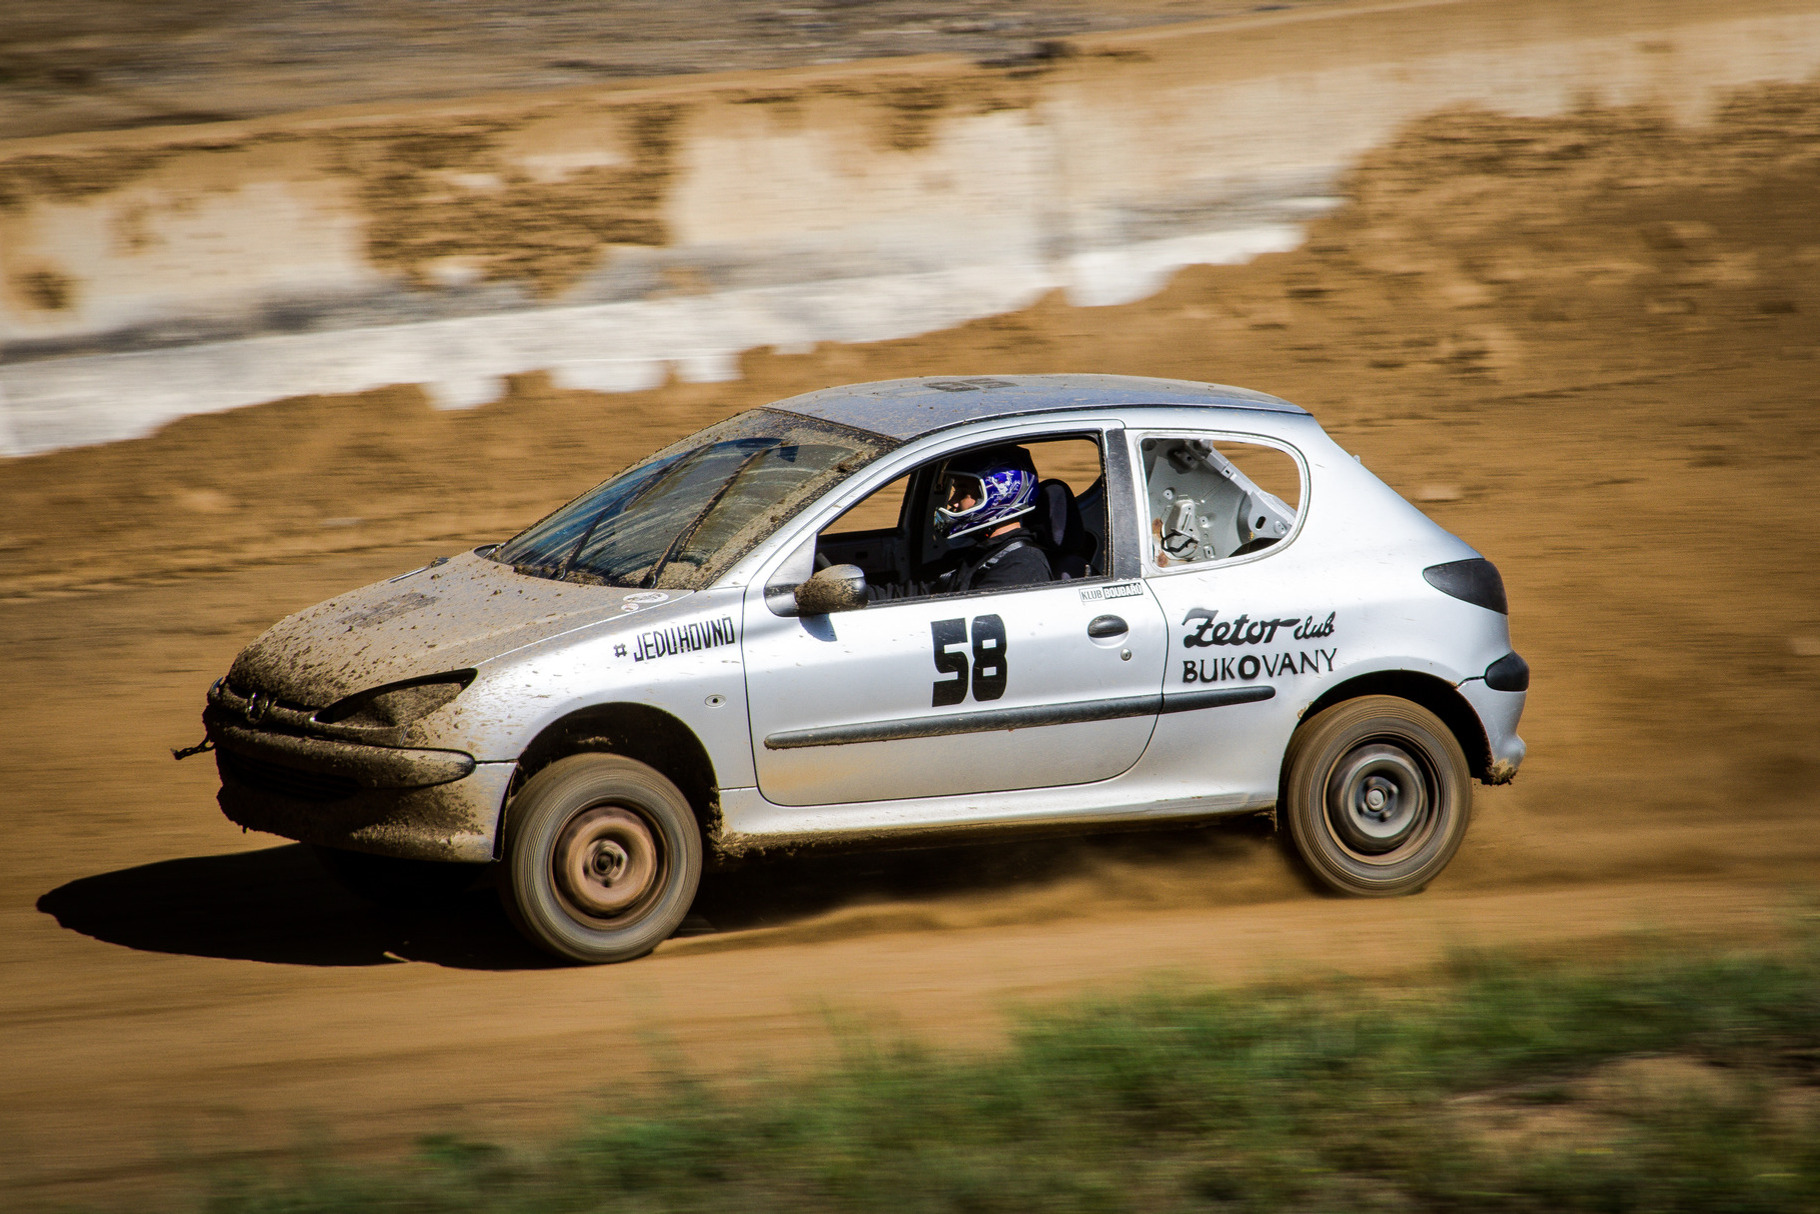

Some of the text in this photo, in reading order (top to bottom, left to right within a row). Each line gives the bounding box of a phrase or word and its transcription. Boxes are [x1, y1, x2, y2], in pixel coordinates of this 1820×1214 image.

[1081, 589, 1103, 600] KLUB
[1182, 607, 1336, 648] Zetor club
[930, 613, 1008, 707] 58
[1182, 648, 1337, 683] BUKOVANY
